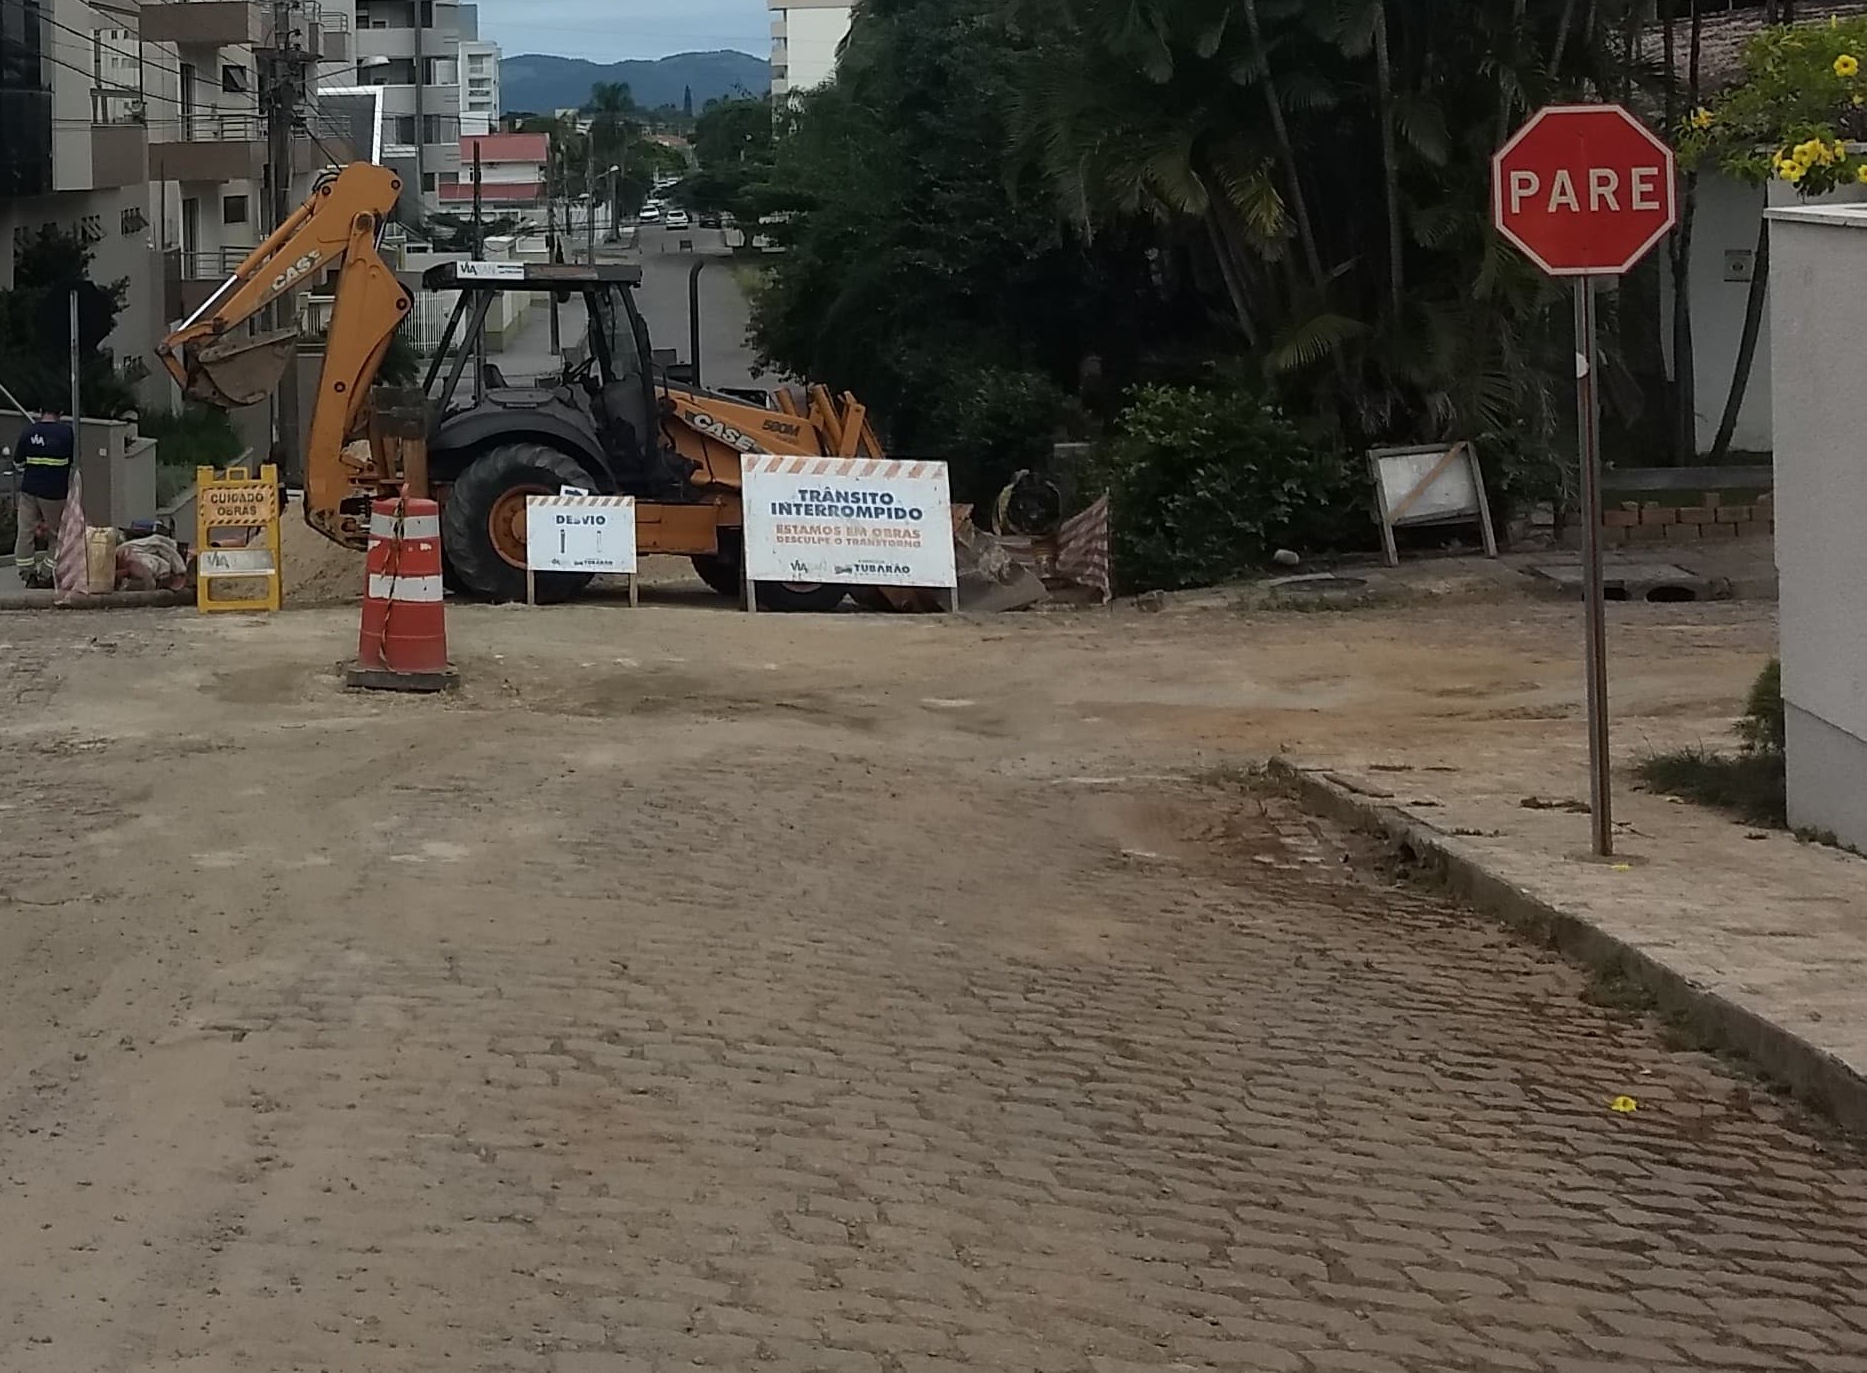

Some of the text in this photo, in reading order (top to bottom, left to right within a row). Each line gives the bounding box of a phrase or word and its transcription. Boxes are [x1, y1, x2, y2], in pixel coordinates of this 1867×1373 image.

[1509, 166, 1661, 214] PARE
[693, 413, 756, 451] CASE
[210, 492, 264, 504] CUIDADO
[798, 486, 894, 505] TRÂNSITO
[217, 506, 257, 516] OBRAS
[770, 502, 924, 521] INTERROMPIDO
[555, 514, 606, 525] DESVIO
[775, 523, 921, 539] ESTAMOS EM OBRAS
[776, 535, 831, 545] DESCULPE
[834, 537, 843, 545] O
